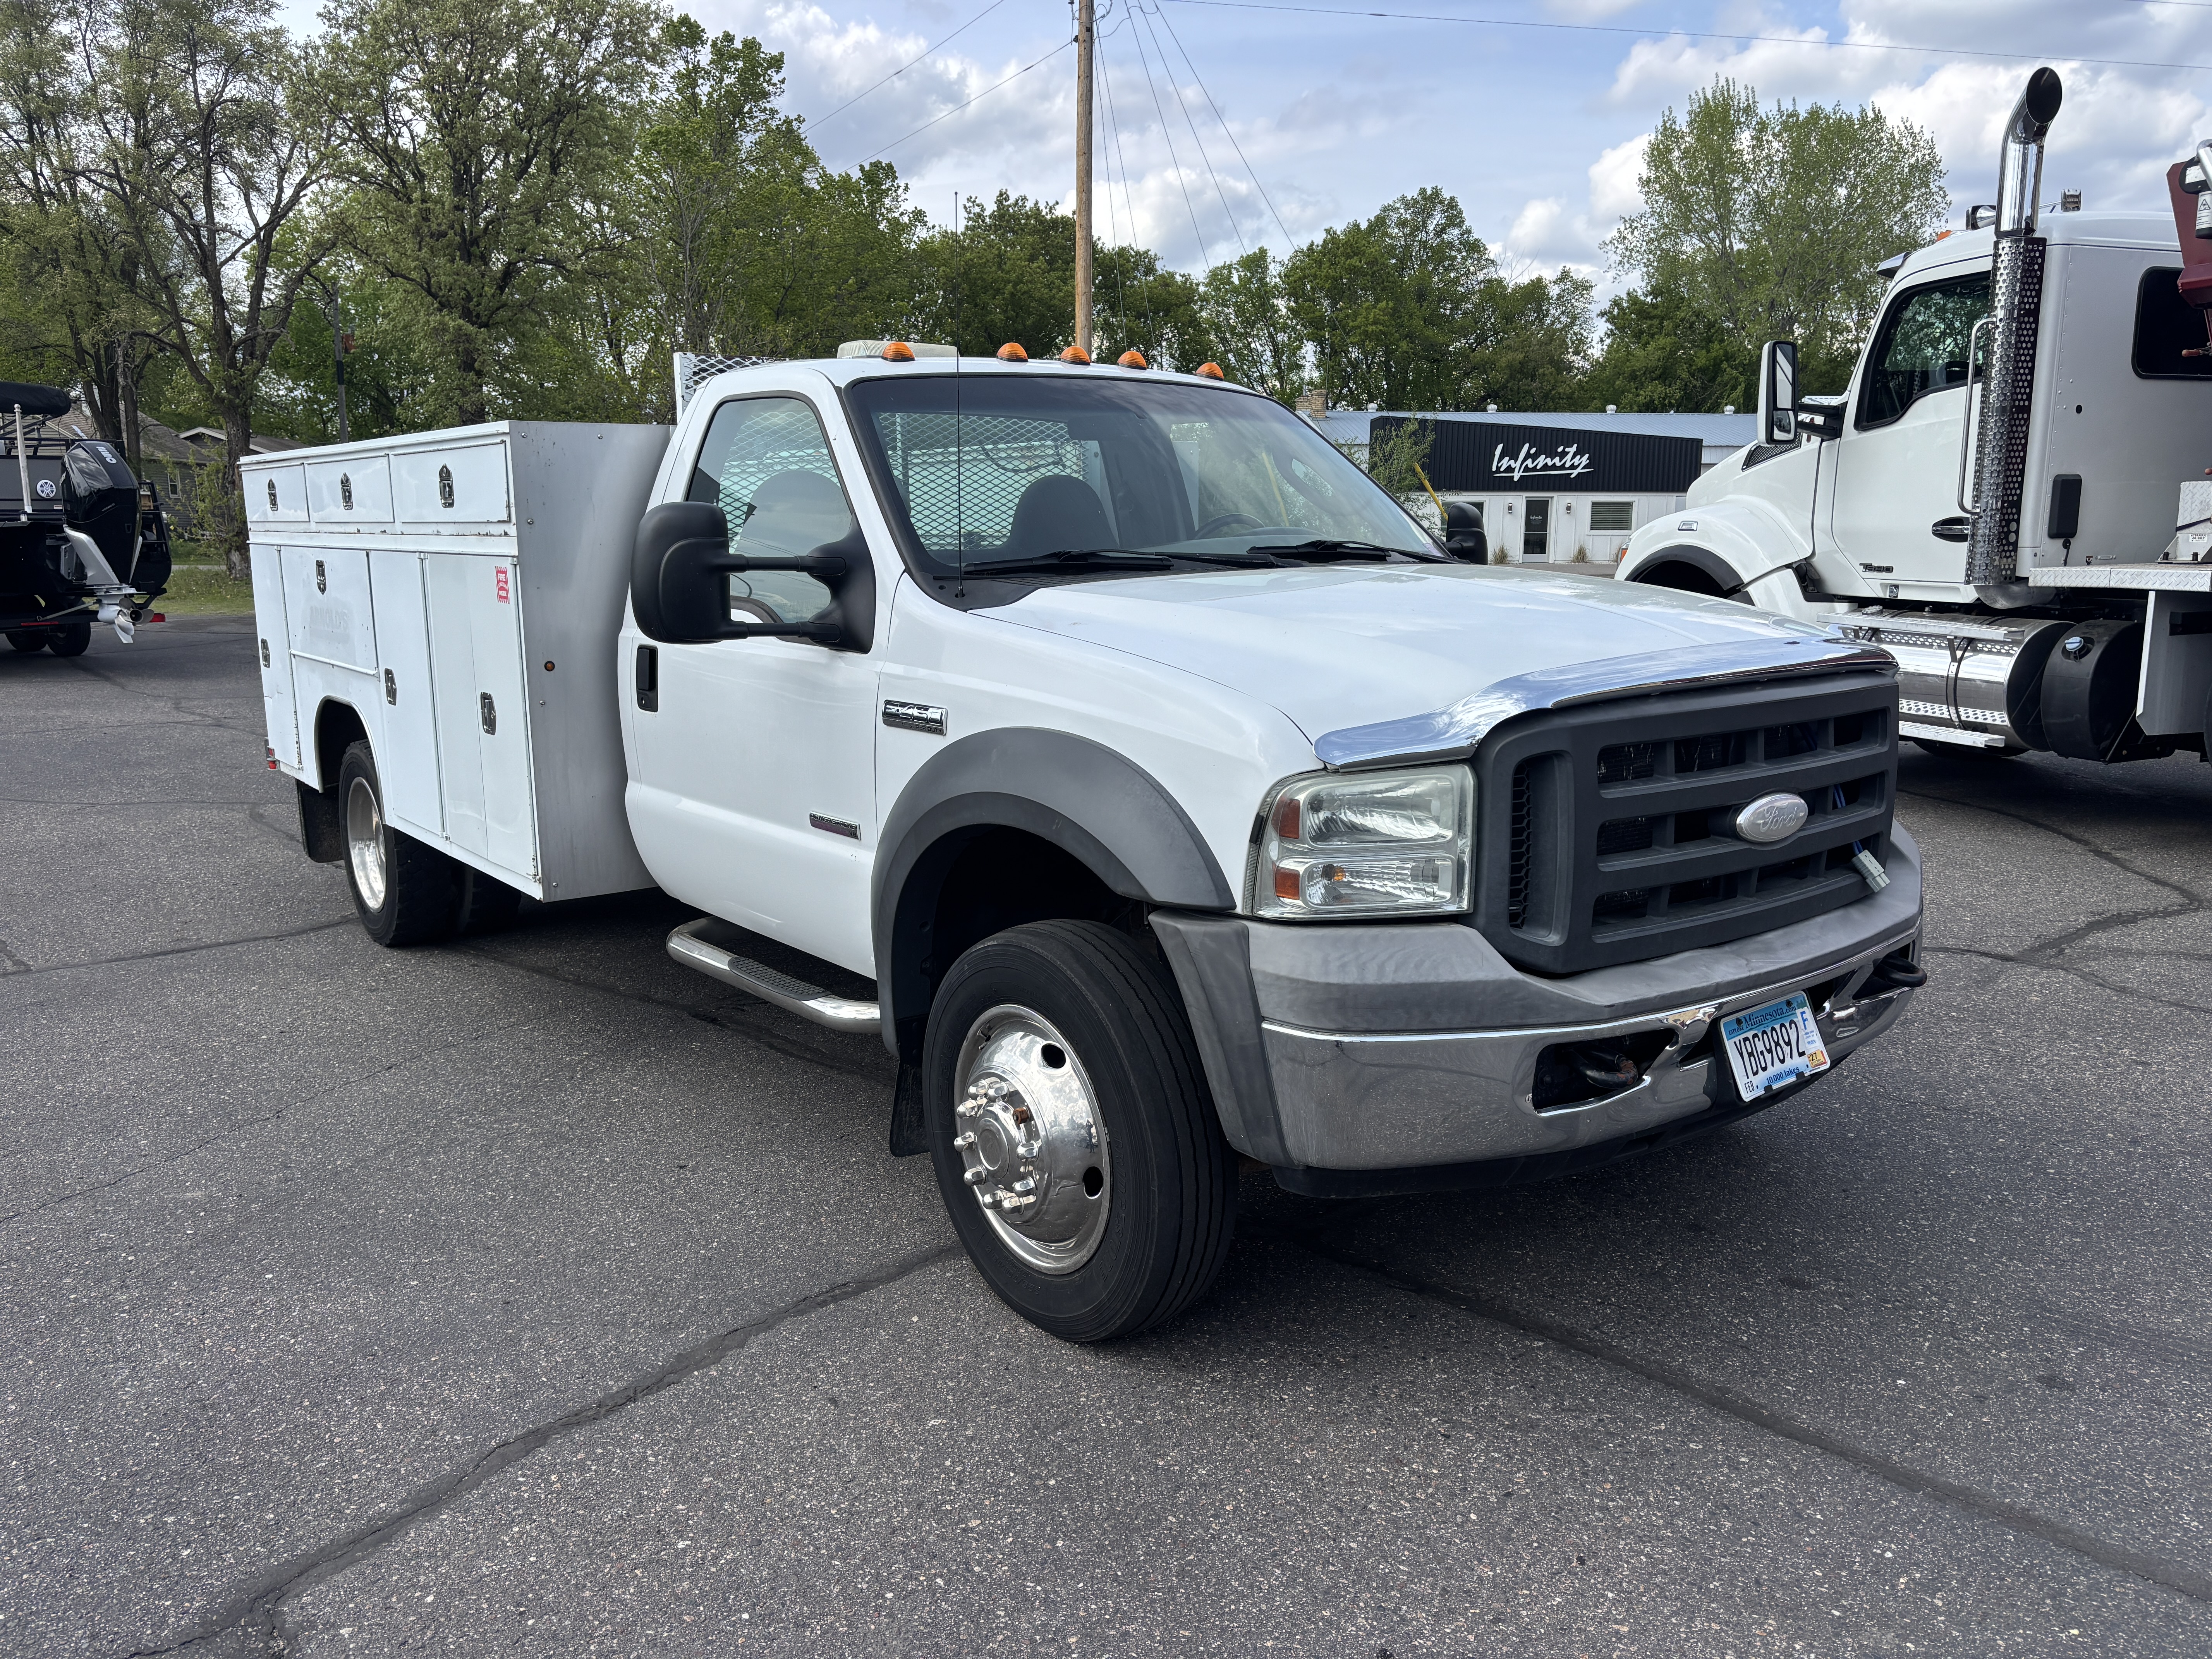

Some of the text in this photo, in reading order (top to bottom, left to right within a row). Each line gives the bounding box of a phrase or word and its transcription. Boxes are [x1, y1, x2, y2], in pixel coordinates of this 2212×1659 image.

[1492, 443, 1590, 481] Infinity
[1759, 802, 1798, 832] Ford
[1743, 1006, 1796, 1029] Minnesota.com
[1800, 1011, 1808, 1030] F
[1733, 1019, 1806, 1080] YBG9892
[1810, 1052, 1817, 1061] 27
[1766, 1066, 1800, 1084] 10,000 lakes
[1744, 1080, 1755, 1094] FEB
